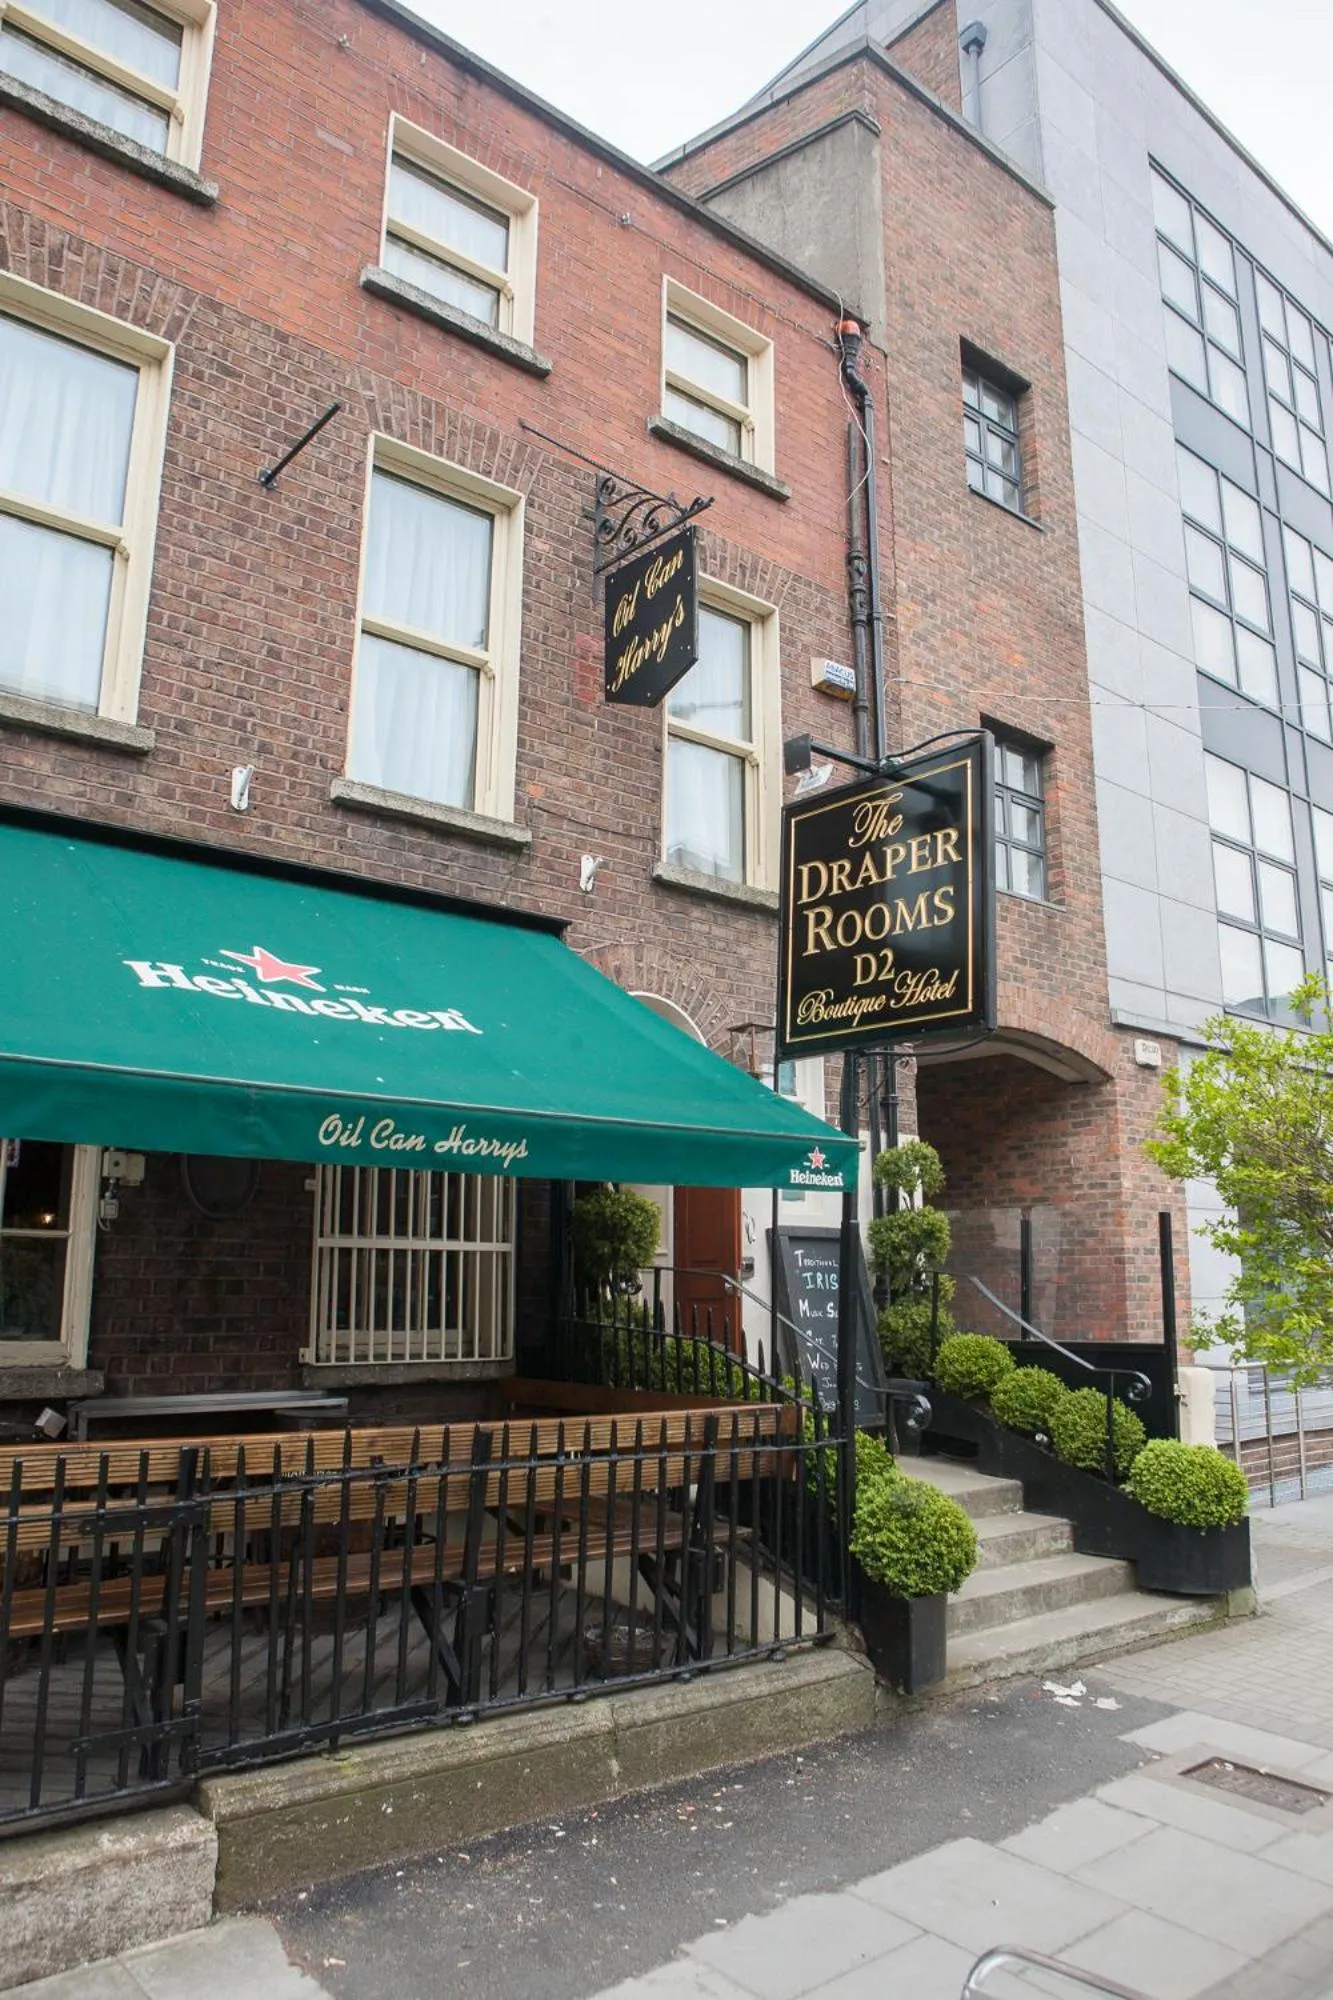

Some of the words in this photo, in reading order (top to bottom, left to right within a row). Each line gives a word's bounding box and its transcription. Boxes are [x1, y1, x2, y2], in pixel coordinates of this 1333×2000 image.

[613, 580, 640, 638] Oil
[645, 550, 684, 600] Can
[611, 594, 685, 693] Harry's
[849, 792, 903, 848] The
[797, 827, 963, 905] DRAPER
[802, 885, 956, 957] ROOMS
[123, 960, 483, 1034] Heineken
[853, 948, 896, 987] D2
[797, 988, 887, 1027] Boutique
[890, 968, 960, 1008] Hotel
[318, 1113, 366, 1147] Oil
[370, 1118, 426, 1151] Can
[434, 1125, 529, 1168] Harrys
[790, 1169, 844, 1187] Heineken
[802, 1271, 840, 1290] IRIS
